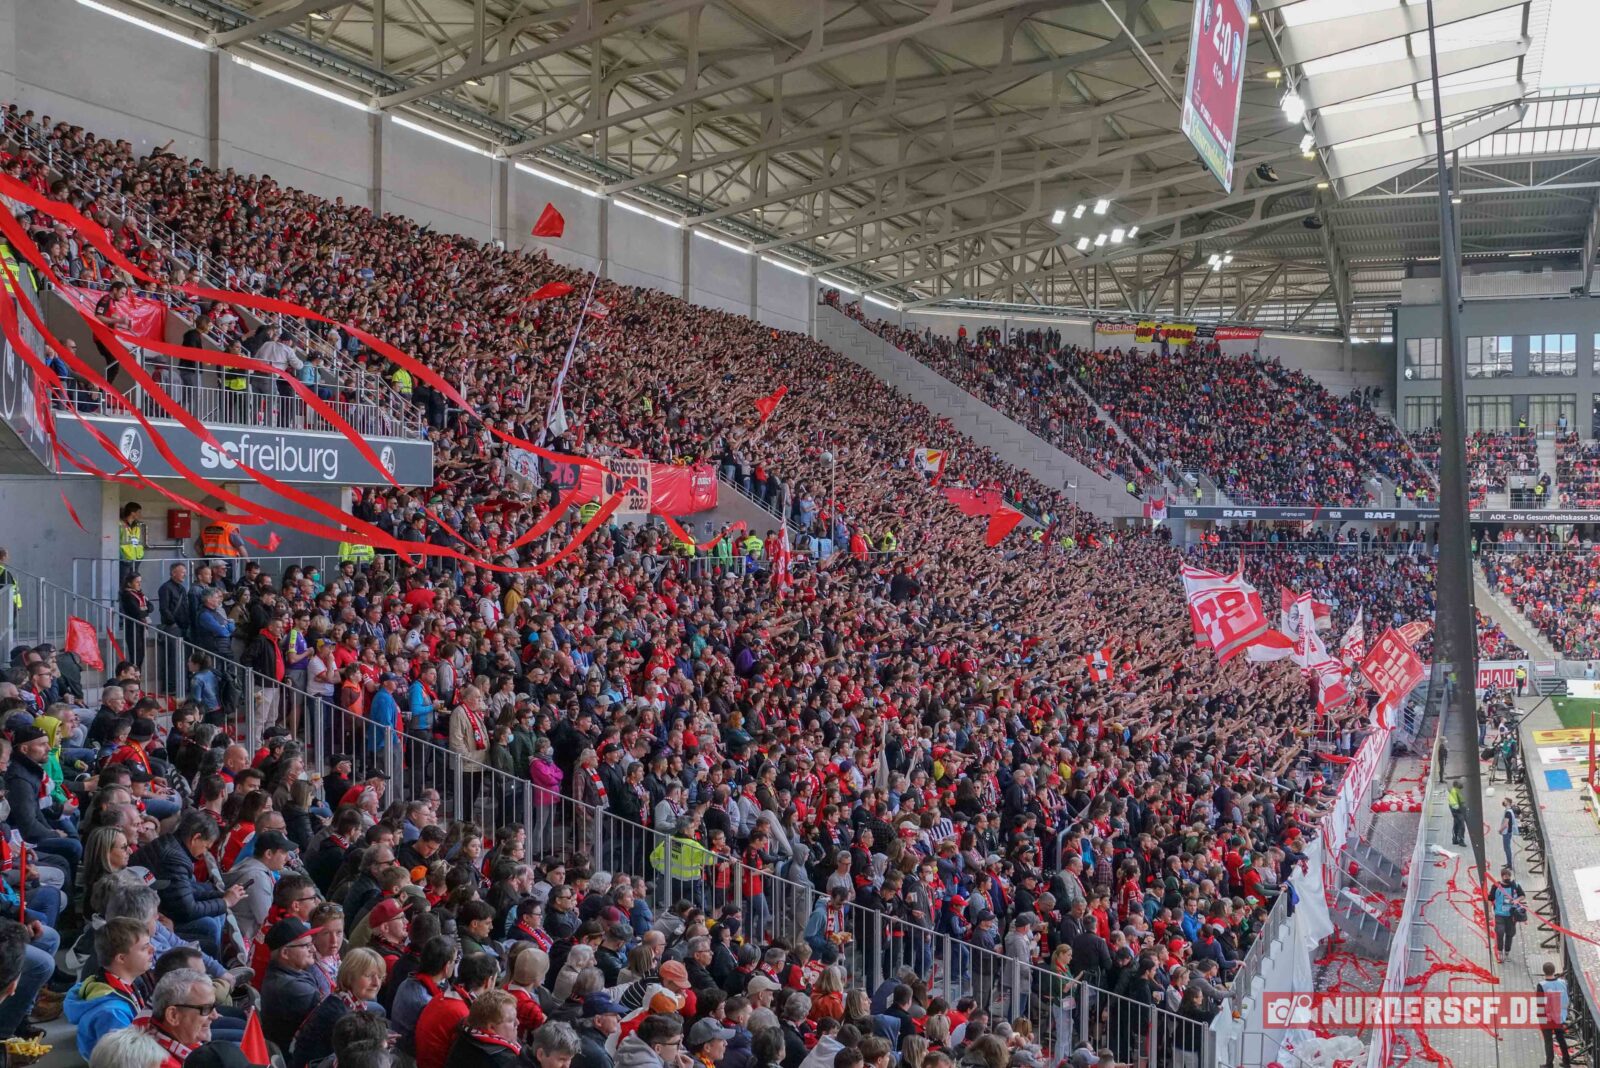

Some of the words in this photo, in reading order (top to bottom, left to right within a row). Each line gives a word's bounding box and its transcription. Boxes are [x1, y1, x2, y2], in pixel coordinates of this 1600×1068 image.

[610, 460, 649, 475] BOYCOTT
[629, 498, 648, 510] 2022
[1364, 511, 1395, 519] RAFI
